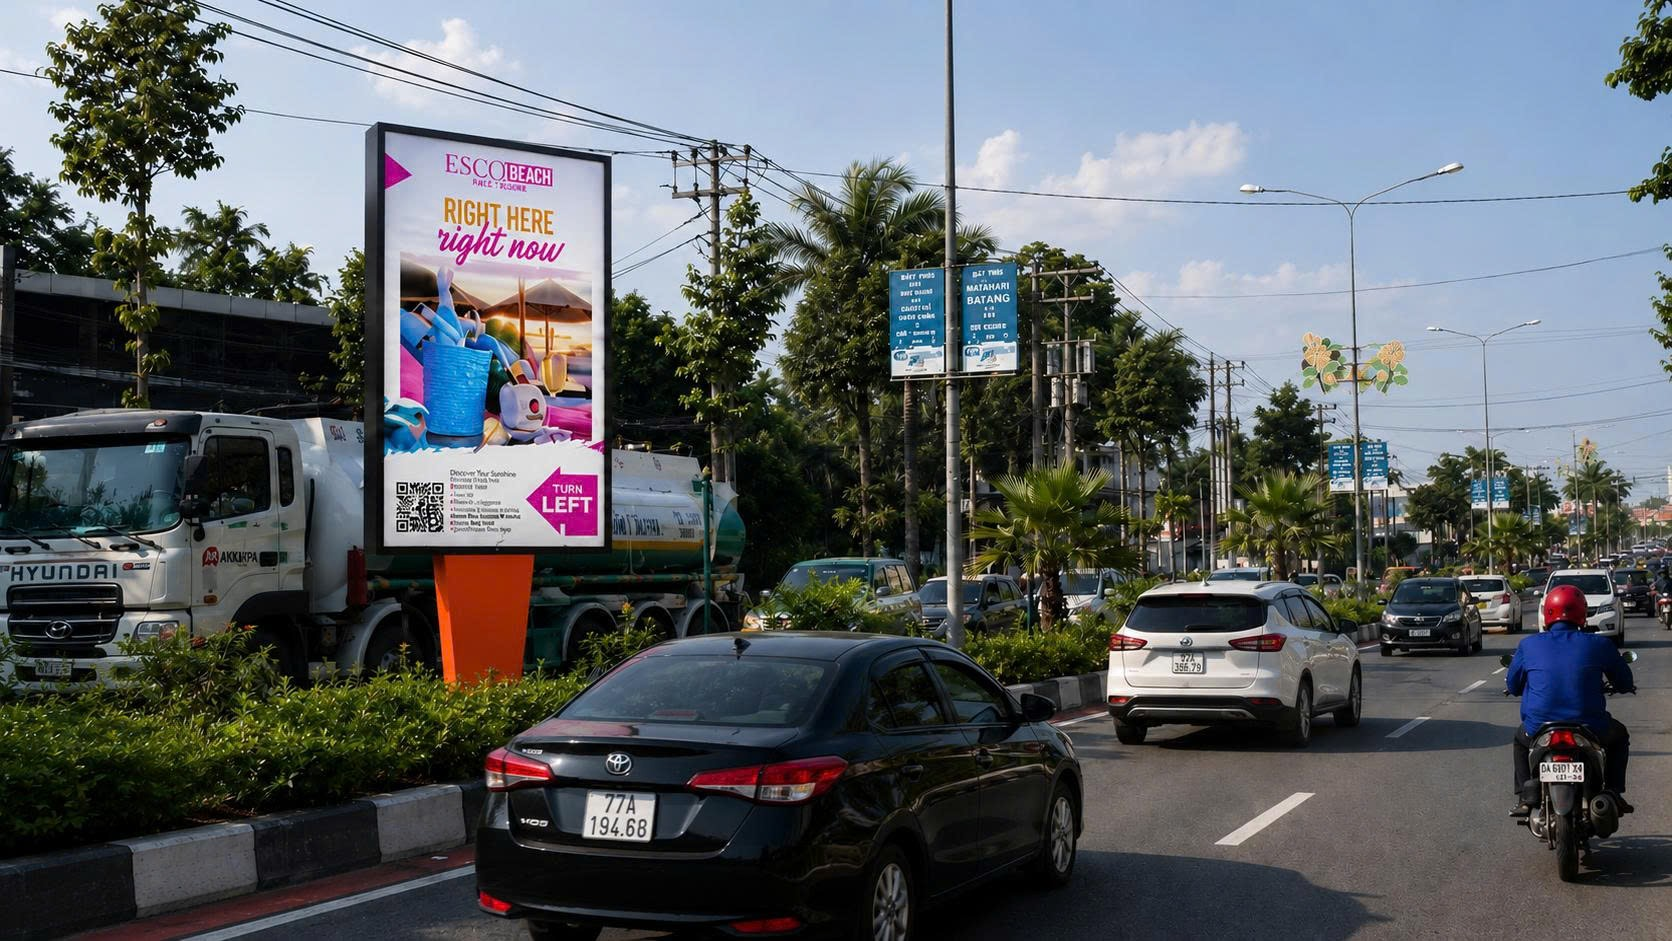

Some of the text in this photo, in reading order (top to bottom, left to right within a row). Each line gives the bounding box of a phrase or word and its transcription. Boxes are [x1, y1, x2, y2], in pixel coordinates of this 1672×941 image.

[509, 164, 551, 186] BEACH
[444, 197, 554, 235] RIGHT HERE
[438, 221, 566, 266] right now
[966, 282, 1010, 292] MATAHARI
[967, 293, 1010, 305] BATANG
[552, 484, 583, 494] TURN
[542, 496, 593, 513] LEFT
[11, 563, 117, 582] HYUNDAI
[605, 793, 636, 814] 77A
[591, 815, 647, 838] 194.68
